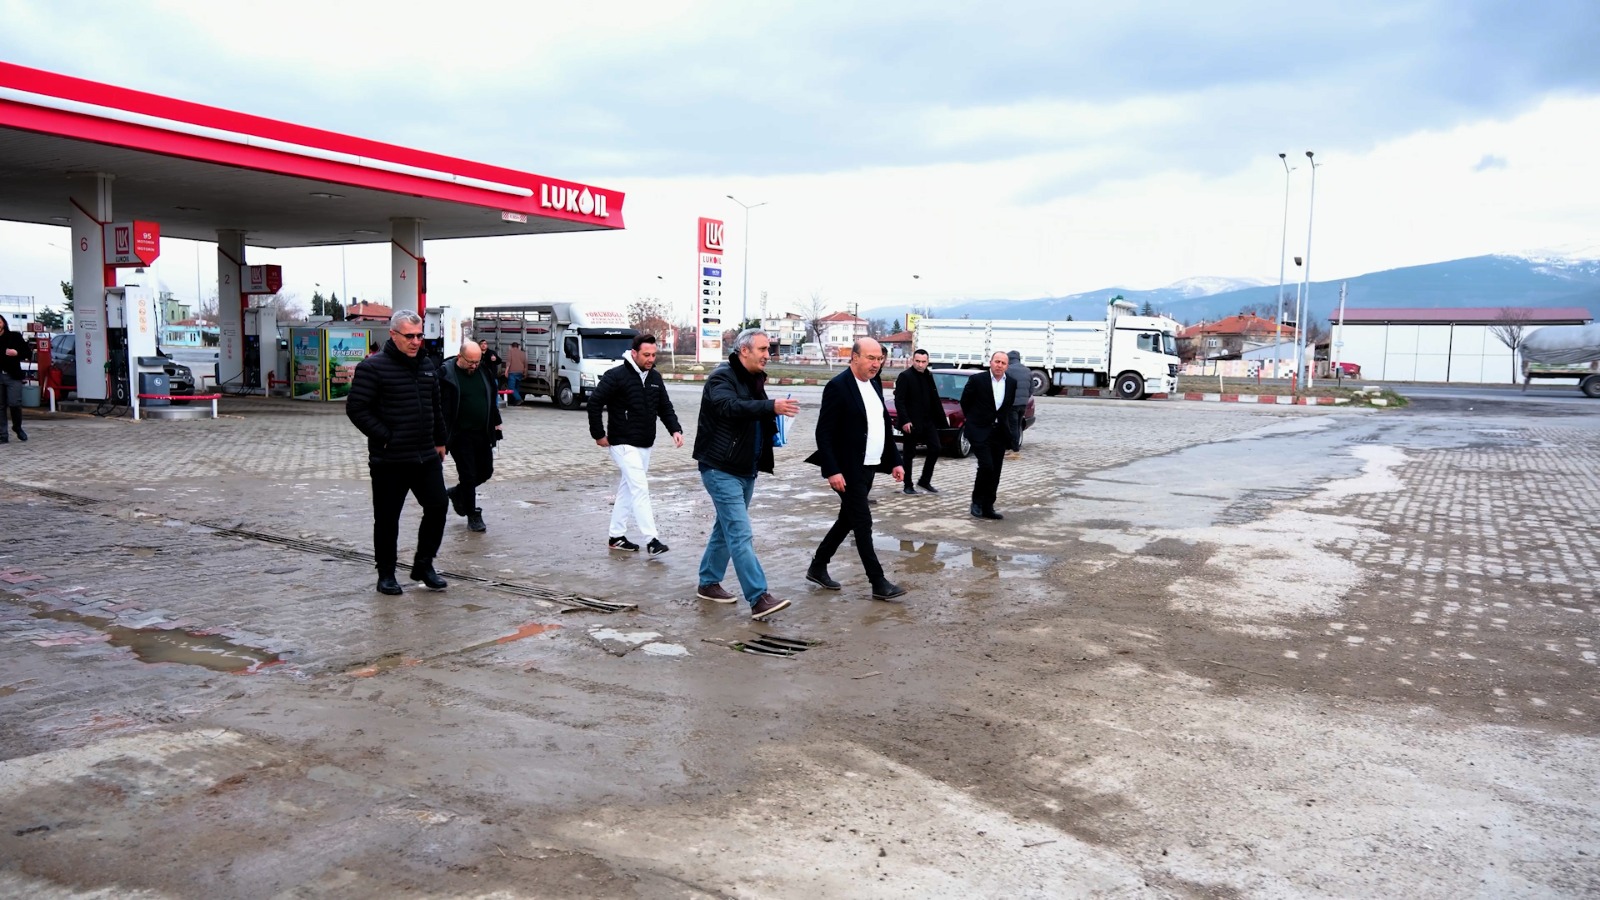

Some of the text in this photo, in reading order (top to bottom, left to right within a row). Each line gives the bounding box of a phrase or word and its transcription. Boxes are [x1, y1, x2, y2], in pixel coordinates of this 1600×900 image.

[540, 183, 610, 218] LUKOIL
[116, 229, 129, 252] LUK
[142, 232, 152, 240] 95
[706, 221, 724, 250] LUK
[80, 236, 89, 252] 6
[702, 255, 722, 265] LUKOIL
[224, 274, 231, 285] 2
[399, 269, 407, 281] 4
